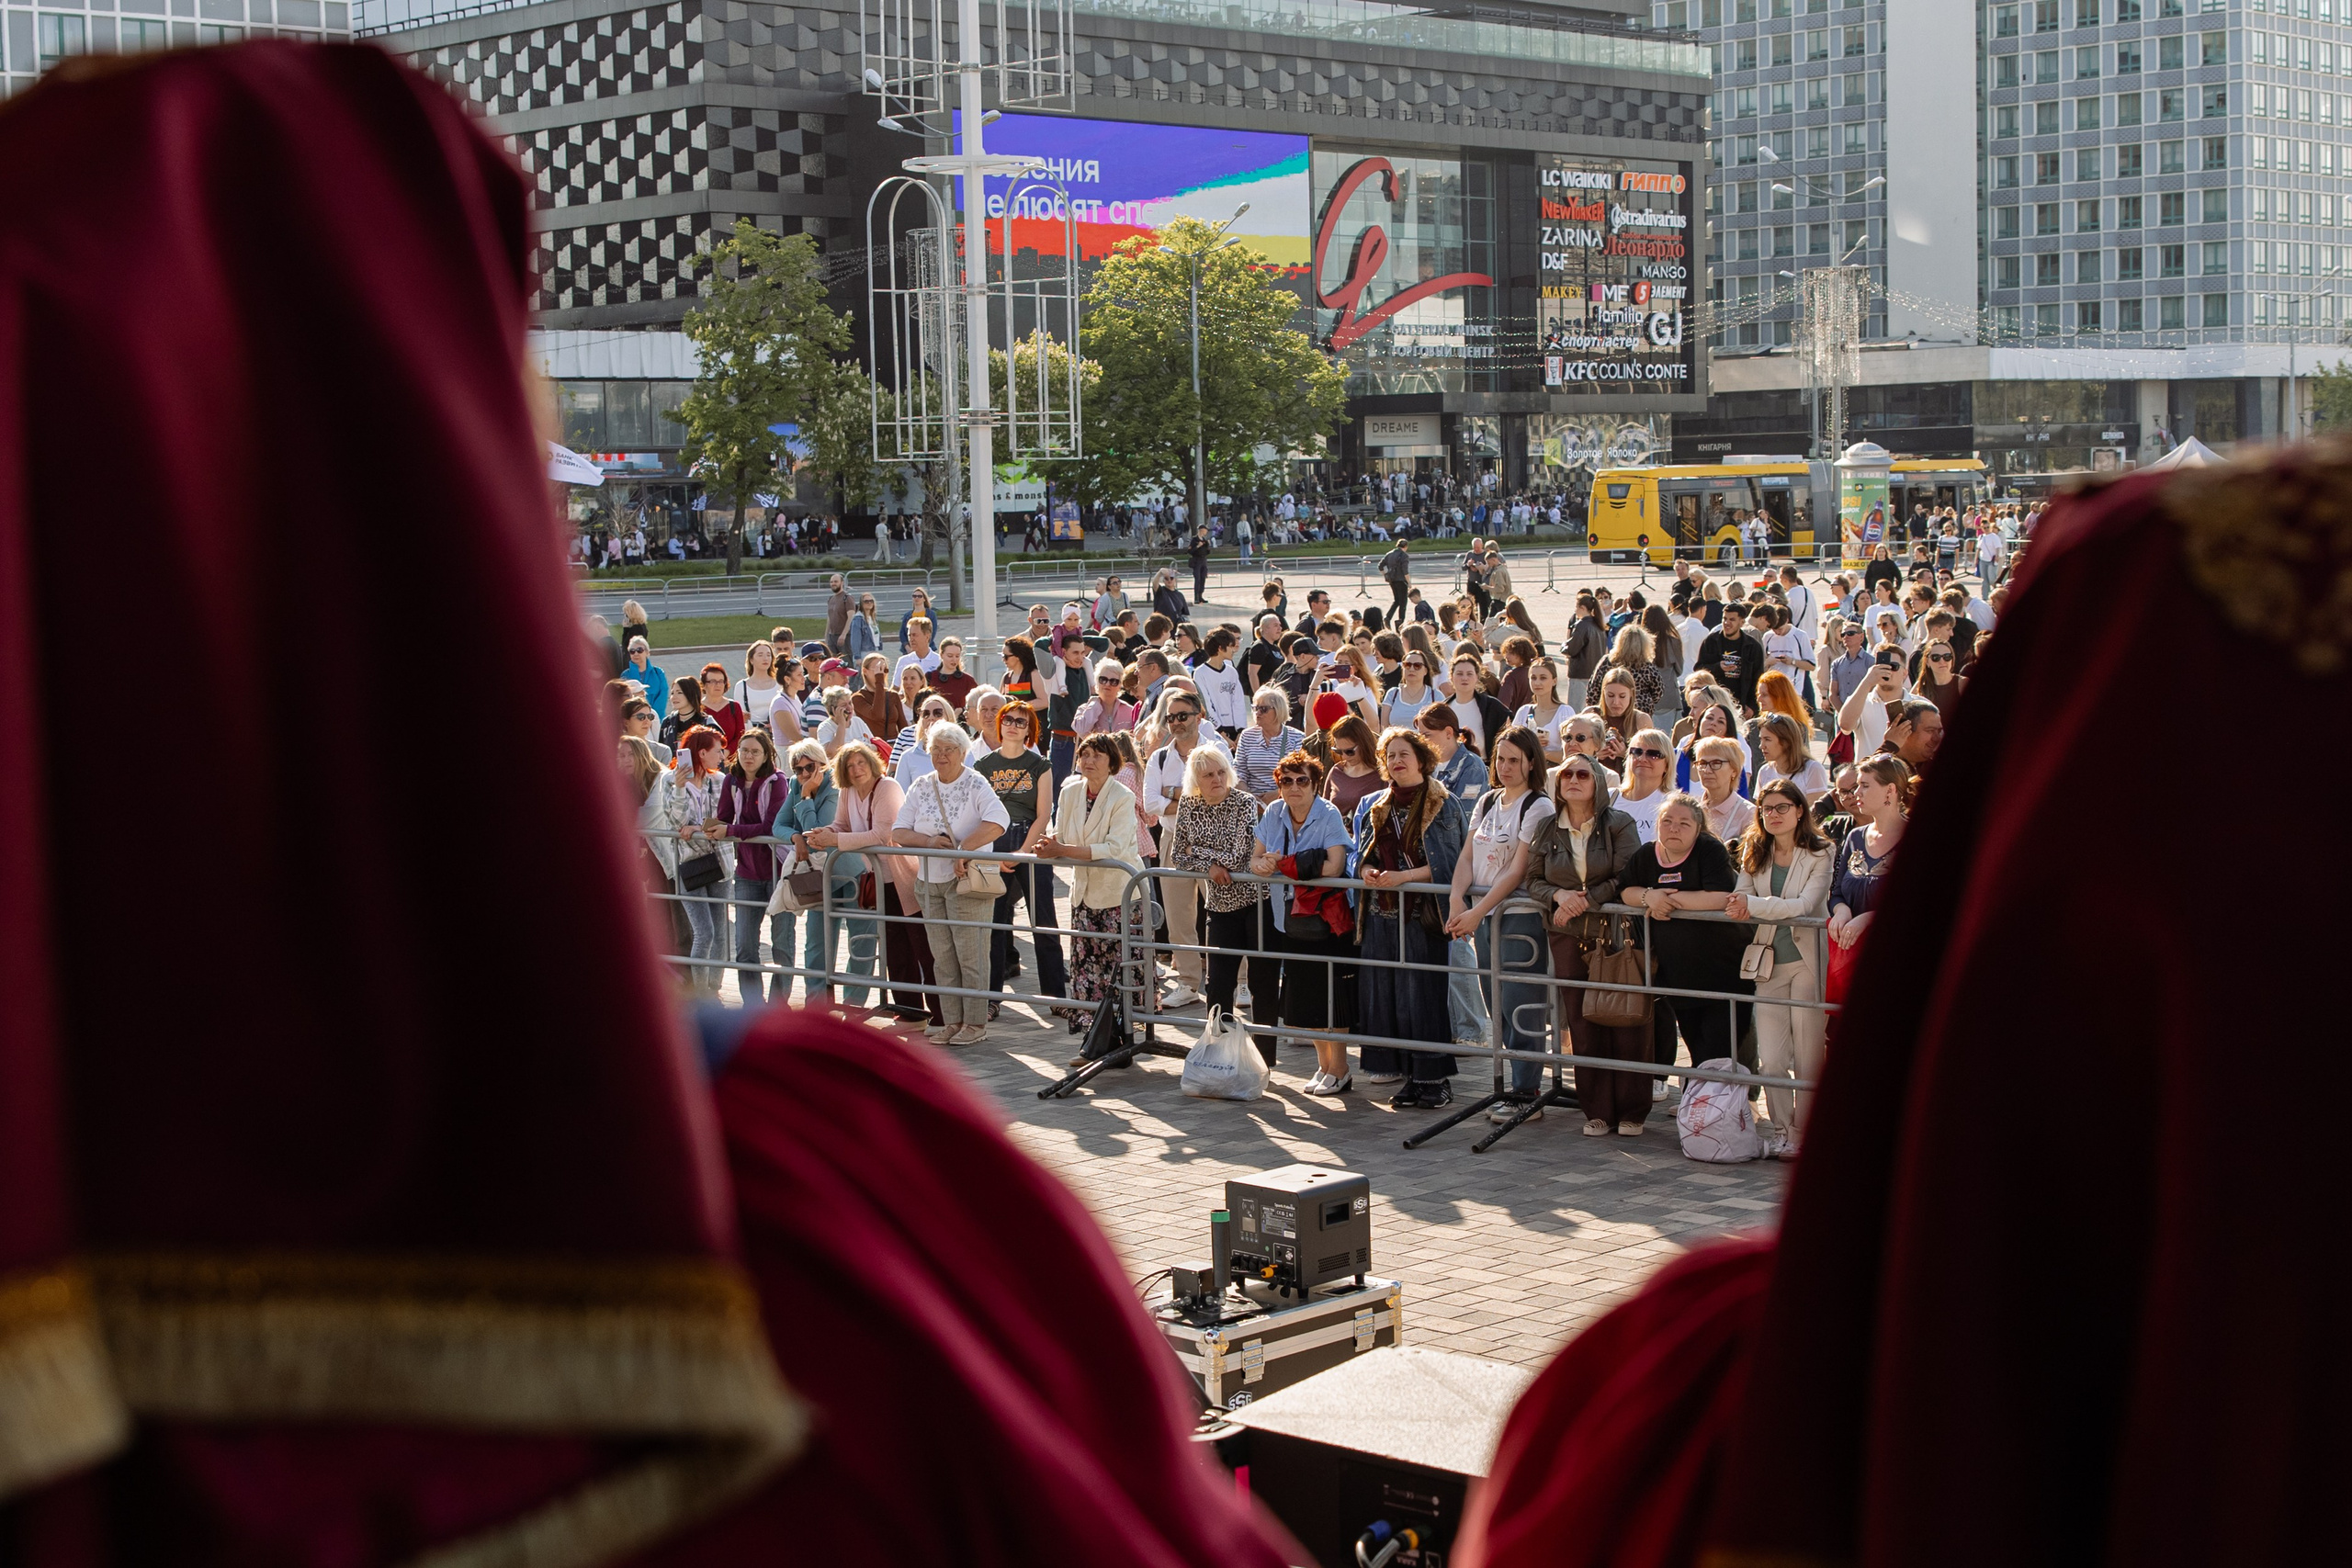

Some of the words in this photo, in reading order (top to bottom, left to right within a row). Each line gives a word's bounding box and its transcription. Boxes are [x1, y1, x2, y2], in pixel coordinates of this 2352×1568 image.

[1542, 169, 1560, 186] LC
[1012, 191, 1102, 222] любят
[1542, 227, 1604, 247] ZARINA
[1603, 236, 1685, 262] Леонардо
[1642, 265, 1687, 279] MANGO
[1542, 286, 1582, 299] MAKEY
[1601, 284, 1630, 301] MF
[1639, 284, 1647, 301] 5
[1651, 286, 1687, 299] ЭЛЕМЕНТ
[1598, 306, 1644, 323] familia
[1454, 324, 1494, 336] MINSK
[1648, 312, 1682, 346] GJ
[1457, 346, 1495, 358] ЦЕНТР
[1564, 362, 1598, 380] KFC
[1600, 358, 1642, 379] COLIN'S
[1645, 364, 1687, 378] CONTE
[1373, 423, 1419, 433] DREAME
[556, 452, 573, 460] БАНК
[1566, 448, 1602, 459] Золотое
[1607, 446, 1637, 457] Яблоко
